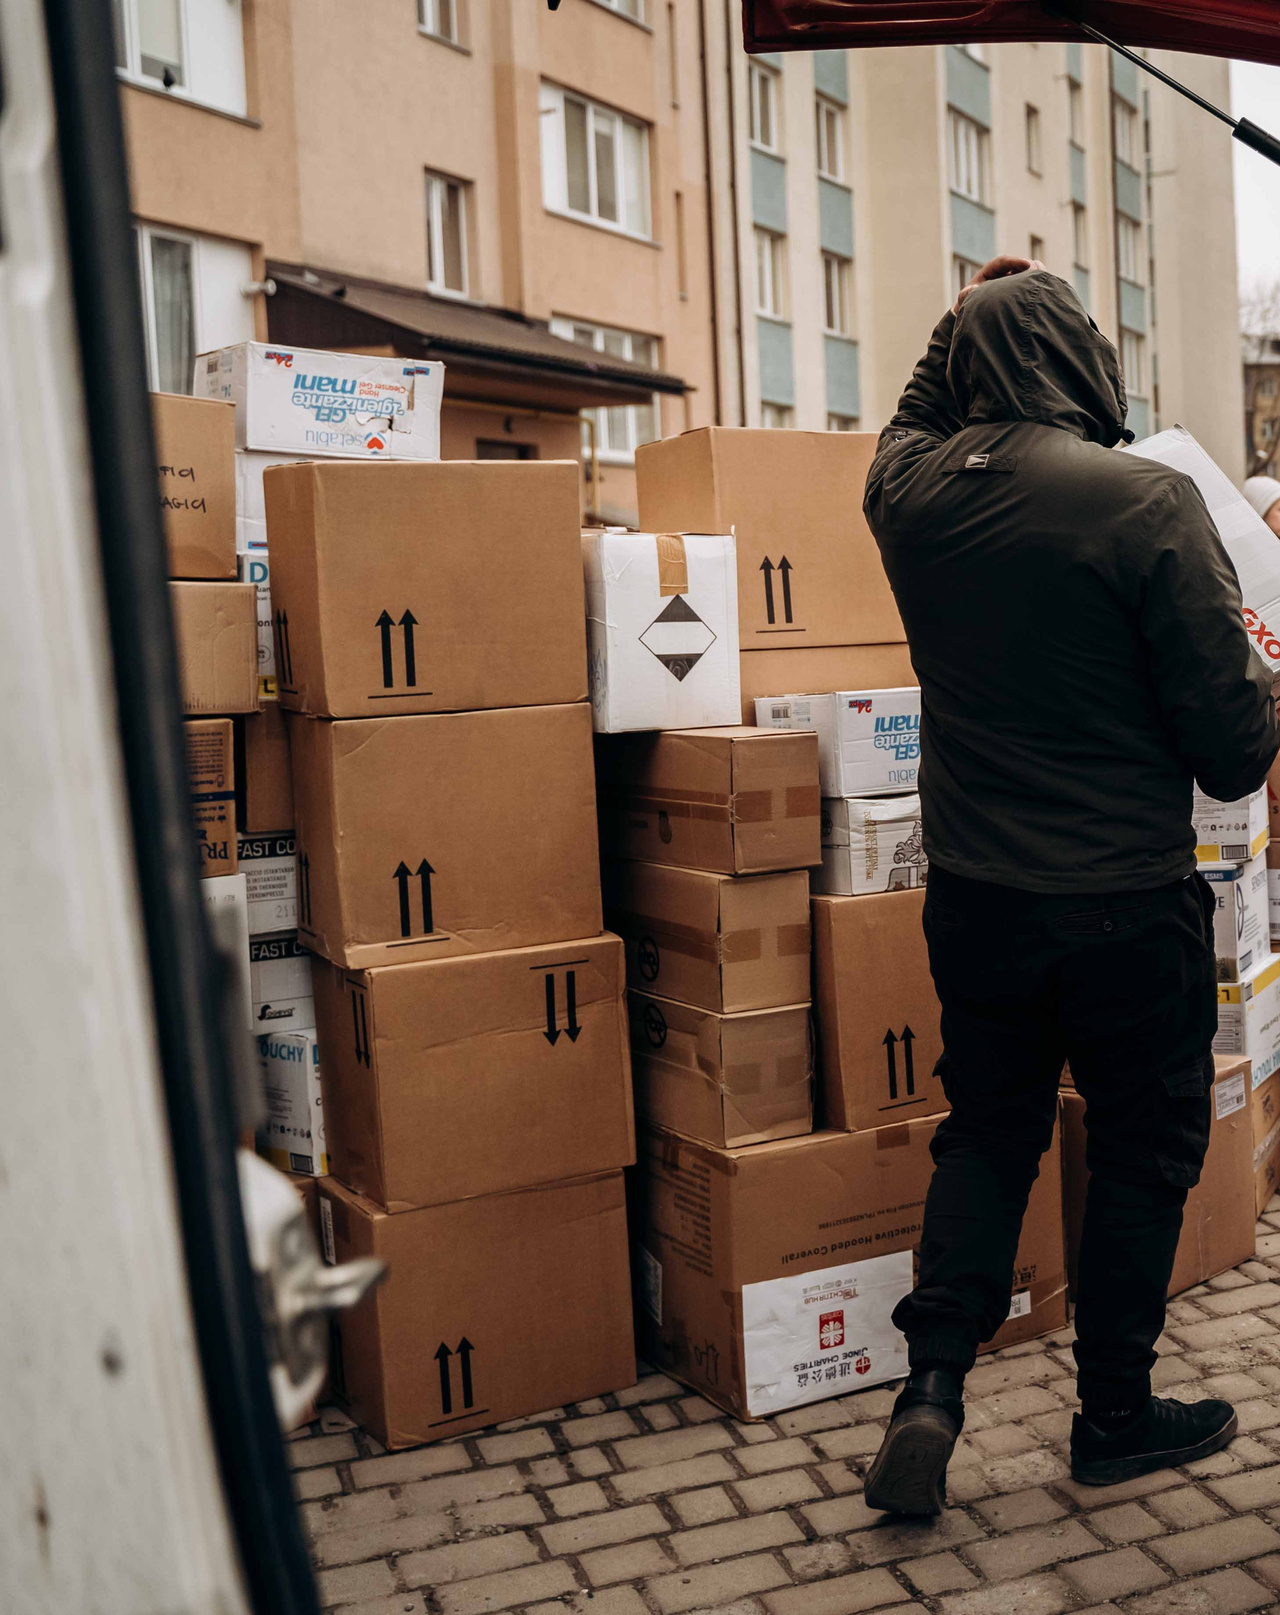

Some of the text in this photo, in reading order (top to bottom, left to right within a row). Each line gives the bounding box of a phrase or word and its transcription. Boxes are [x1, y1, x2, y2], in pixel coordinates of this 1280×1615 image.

[293, 374, 357, 395] mani
[359, 382, 406, 394] Cleanser Gel
[359, 389, 379, 397] Hand
[315, 408, 347, 424] GEL
[305, 430, 363, 447] setablu
[888, 768, 916, 784] ablu
[251, 942, 287, 959] FAST
[259, 1041, 304, 1063] OUCHY
[781, 1224, 922, 1265] rotective Hooded Coverall
[793, 1355, 840, 1372] CHARITIES
